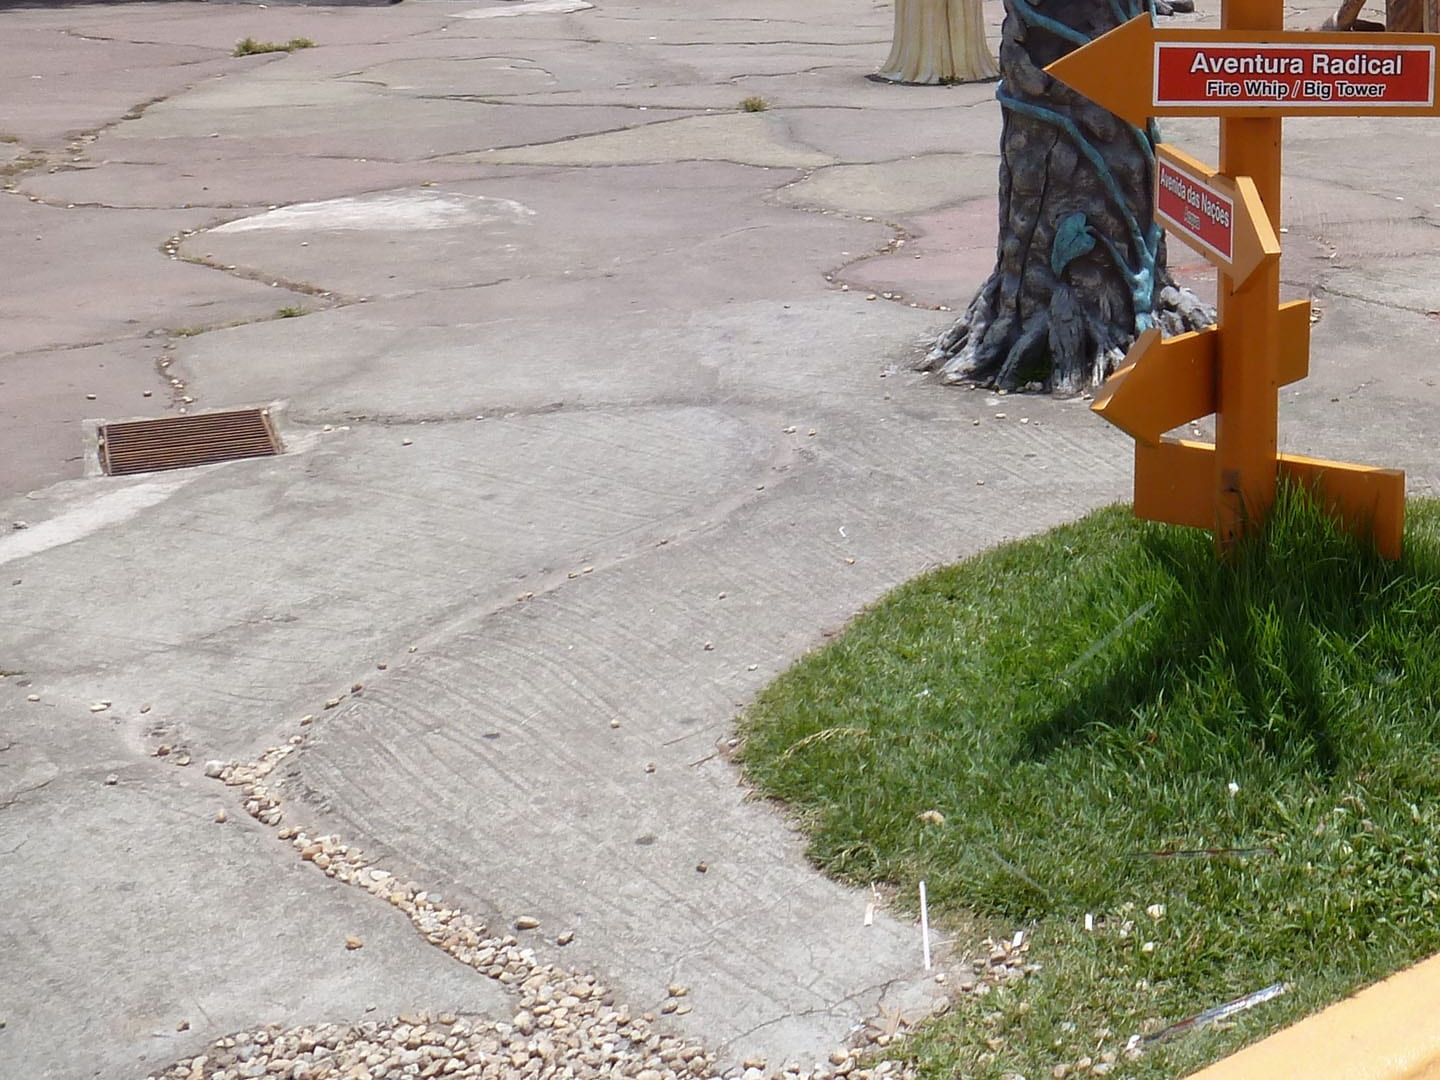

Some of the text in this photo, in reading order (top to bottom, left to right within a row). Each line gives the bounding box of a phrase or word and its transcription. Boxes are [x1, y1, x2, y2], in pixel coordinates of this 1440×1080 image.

[1190, 52, 1402, 75] Aventura Radical
[1206, 81, 1240, 97] Fire
[1245, 81, 1288, 100] Whip
[1303, 81, 1332, 101] Big
[1336, 82, 1385, 98] Tower
[1160, 167, 1186, 200] Avenida
[1187, 185, 1200, 209] das
[1201, 192, 1230, 228] Nações
